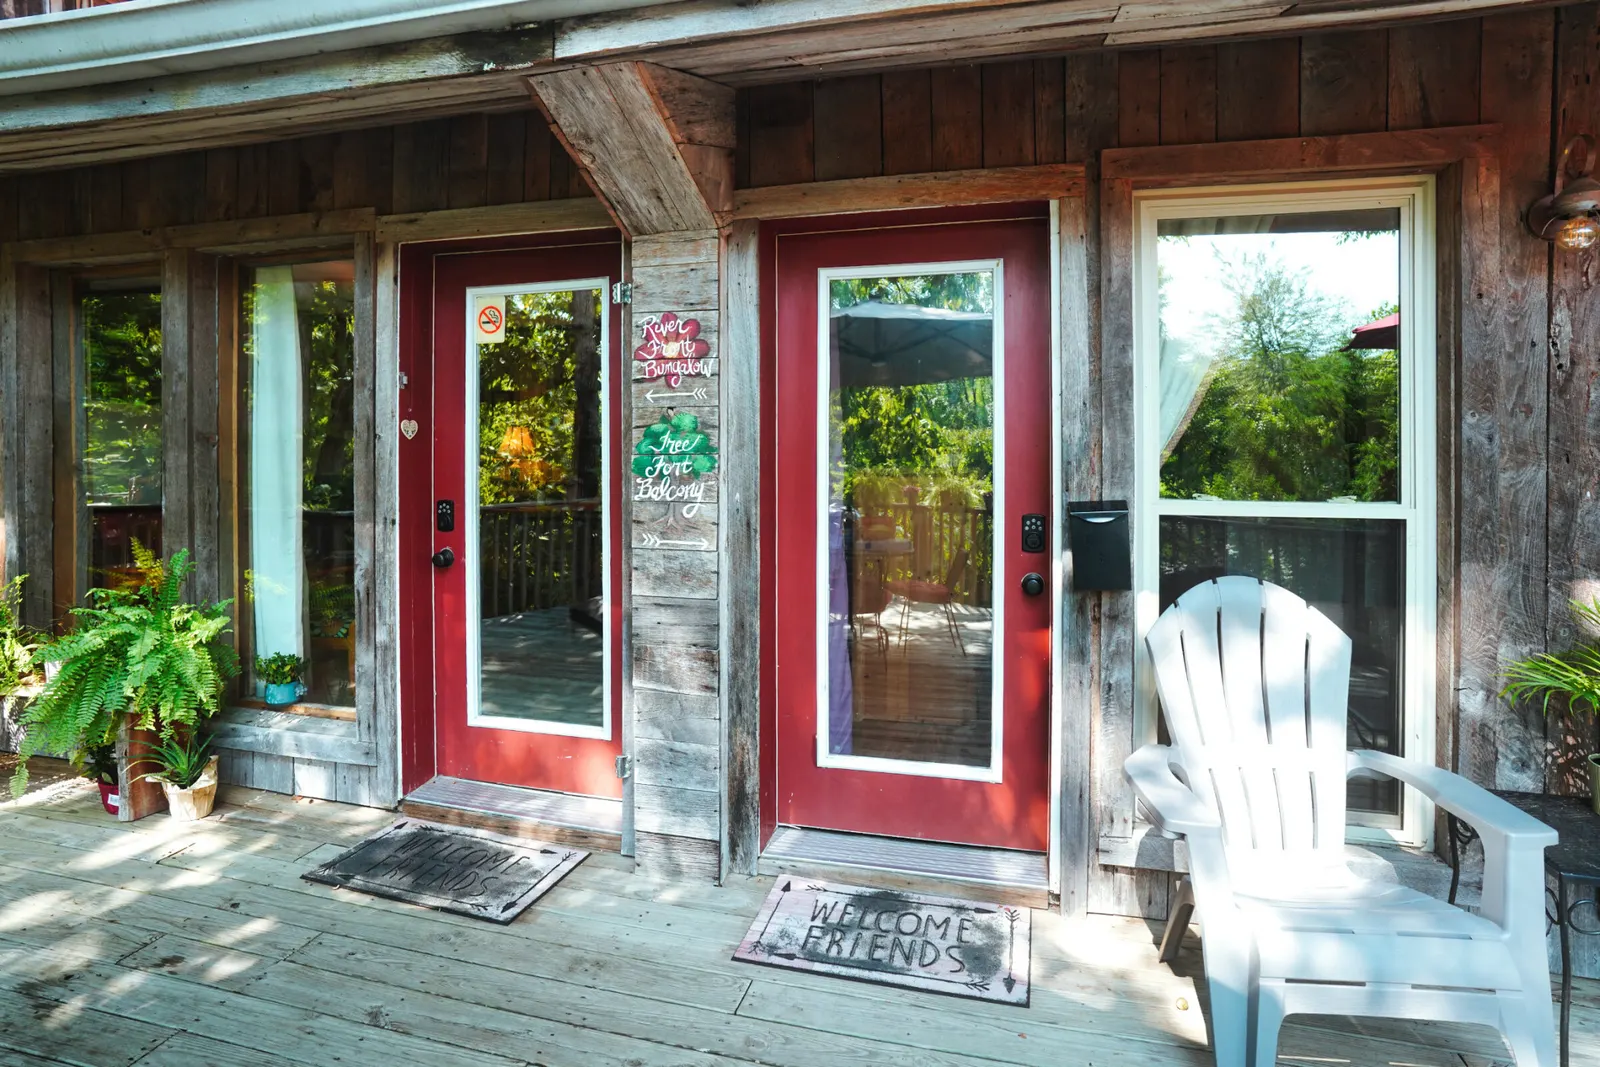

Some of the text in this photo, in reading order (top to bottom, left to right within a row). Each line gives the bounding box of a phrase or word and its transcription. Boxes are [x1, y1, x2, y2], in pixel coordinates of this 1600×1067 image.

[638, 315, 693, 344] River
[638, 335, 696, 359] Front
[636, 354, 716, 387] Bungalow
[648, 430, 701, 454] Tree
[644, 455, 693, 478] Fort
[634, 475, 716, 519] Balcony
[394, 835, 531, 876] WELCOME
[364, 855, 499, 897] FRIENDS
[811, 899, 973, 945] WELCOME
[801, 925, 966, 973] FRIENDS
